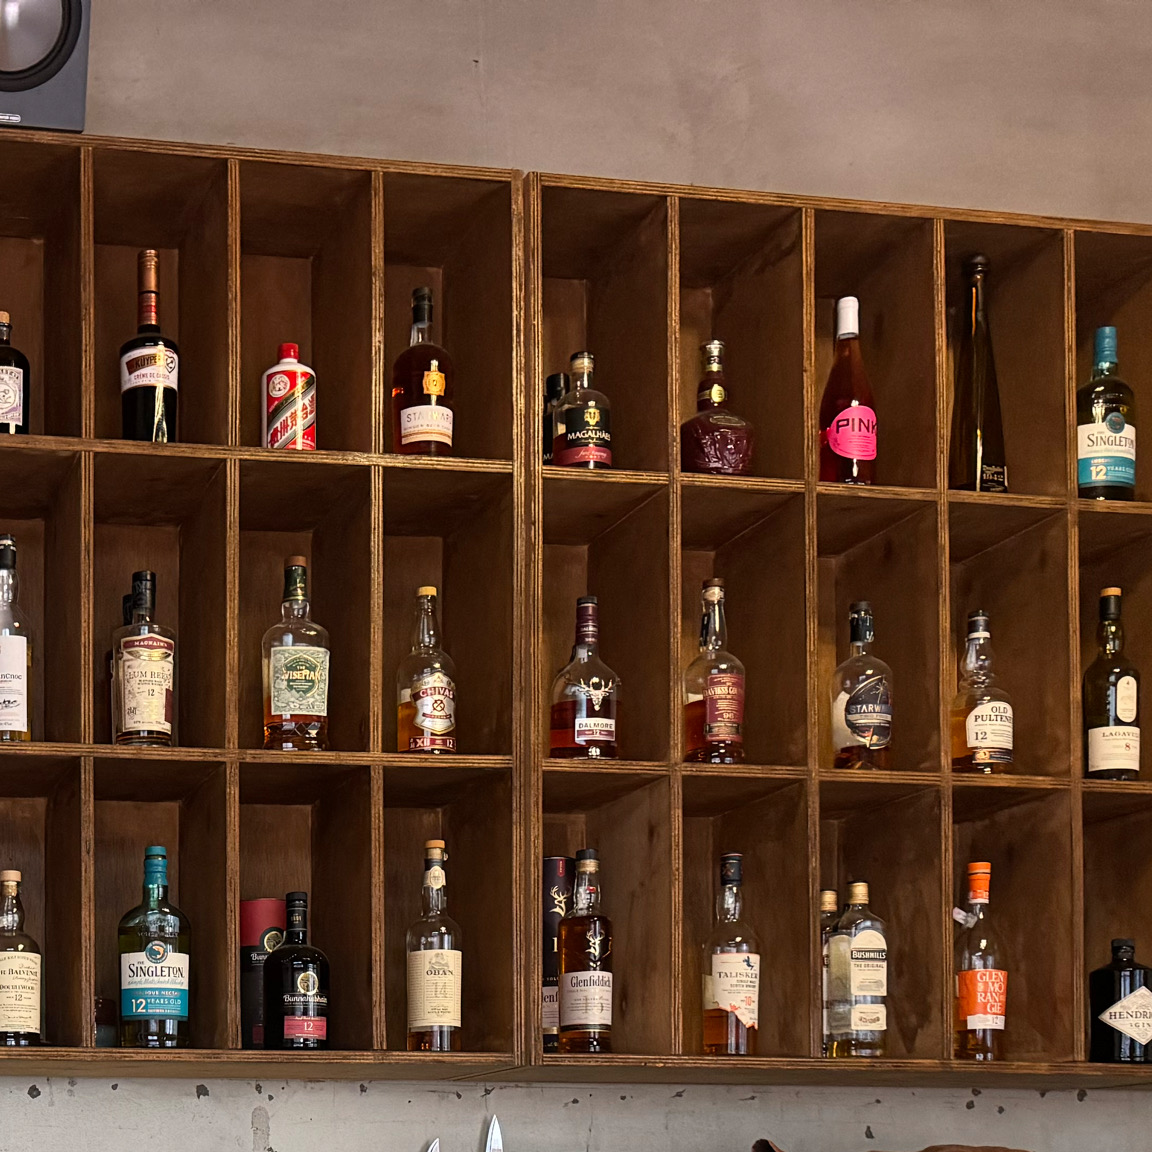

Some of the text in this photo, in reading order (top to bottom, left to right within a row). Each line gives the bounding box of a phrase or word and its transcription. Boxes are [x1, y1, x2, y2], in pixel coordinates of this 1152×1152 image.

[1090, 465, 1107, 480] 12
[147, 689, 155, 697] 12
[420, 687, 453, 699] CHIVAS
[850, 704, 882, 713] STARW
[991, 706, 1008, 714] OLD
[974, 731, 988, 741] 12
[446, 738, 454, 747] 12
[1124, 743, 1131, 751] 8
[852, 951, 887, 959] BUSHMILLS
[128, 964, 185, 979] SINGLETON
[717, 971, 758, 979] TALISKER
[977, 972, 1004, 982] GLEN
[988, 982, 1004, 992] MO
[14, 994, 23, 1002] 12
[744, 996, 752, 1006] 10
[977, 992, 1000, 1003] RAN
[131, 999, 146, 1013] 12
[987, 1003, 1002, 1013] GIE
[991, 1016, 999, 1025] 12
[304, 1022, 314, 1031] 12
